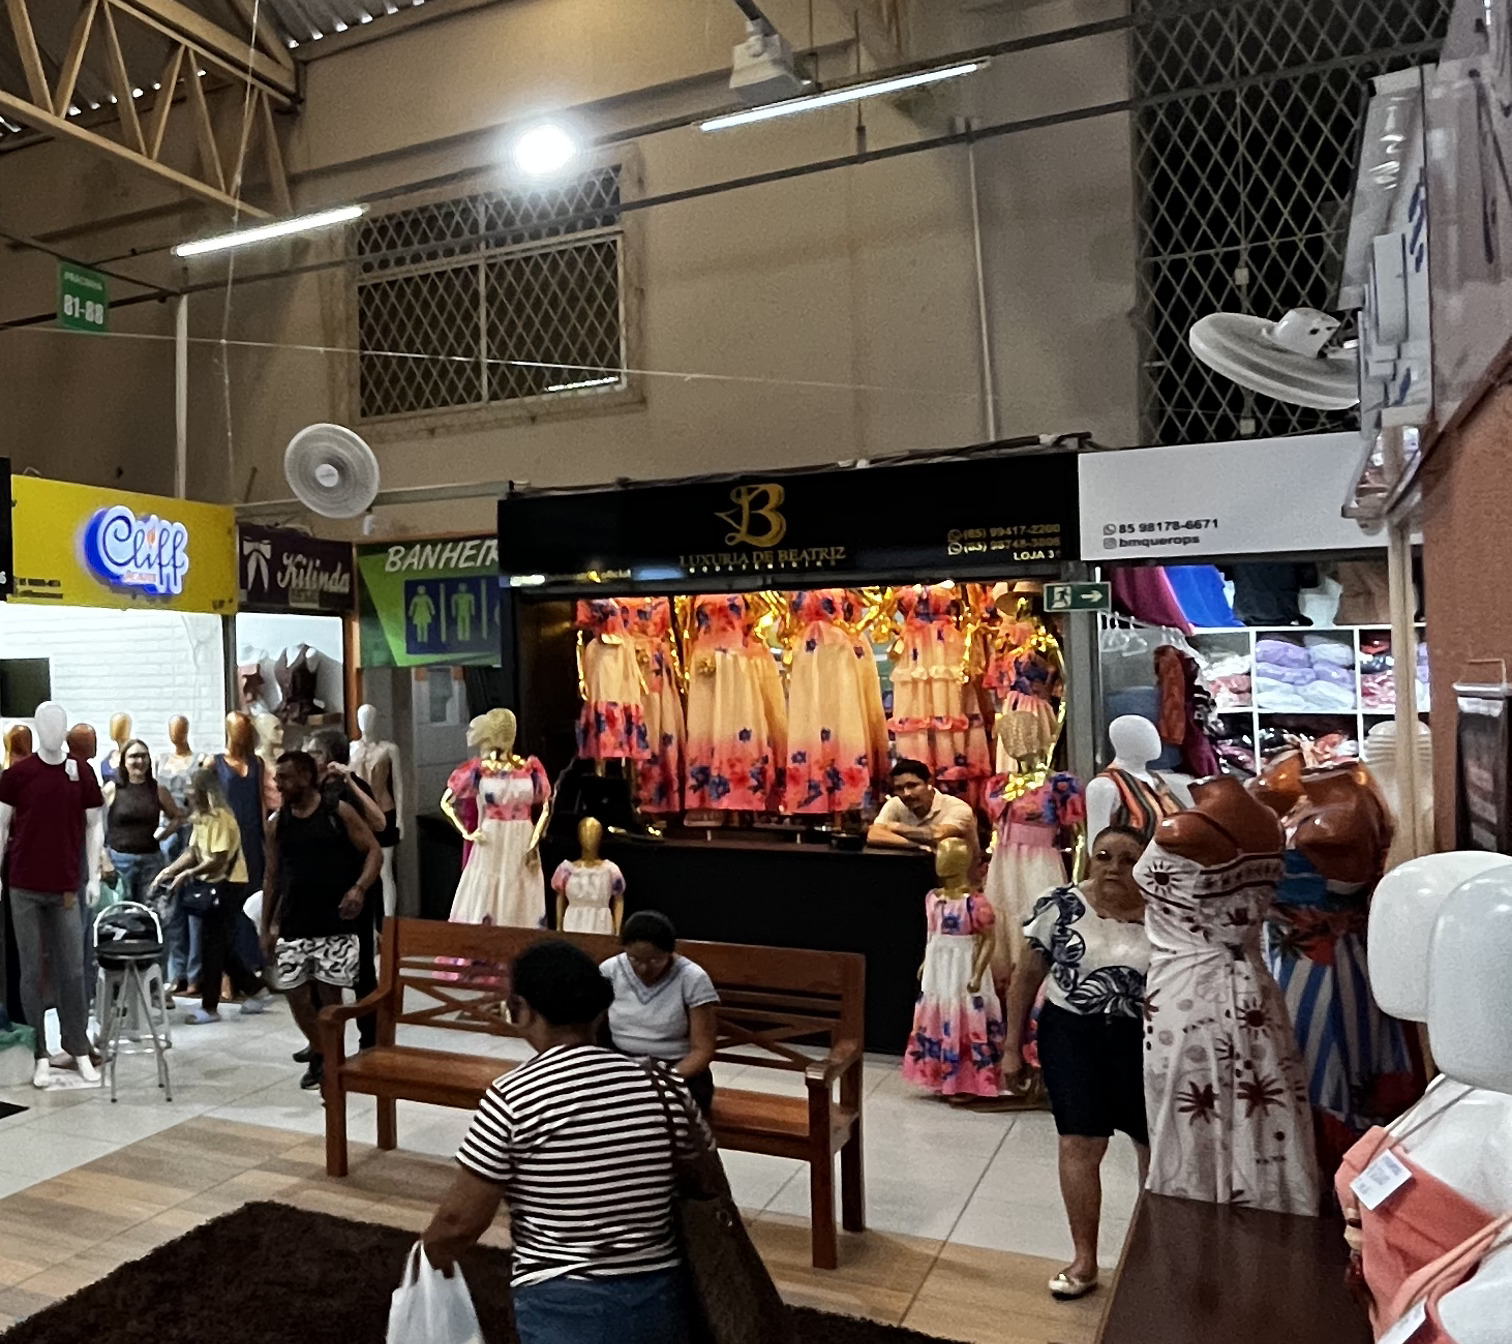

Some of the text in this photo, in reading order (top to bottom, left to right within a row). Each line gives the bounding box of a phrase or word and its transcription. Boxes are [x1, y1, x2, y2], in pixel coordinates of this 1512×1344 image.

[1119, 524, 1135, 533] 85
[102, 515, 185, 587] Cliff
[1013, 551, 1045, 560] LOJA
